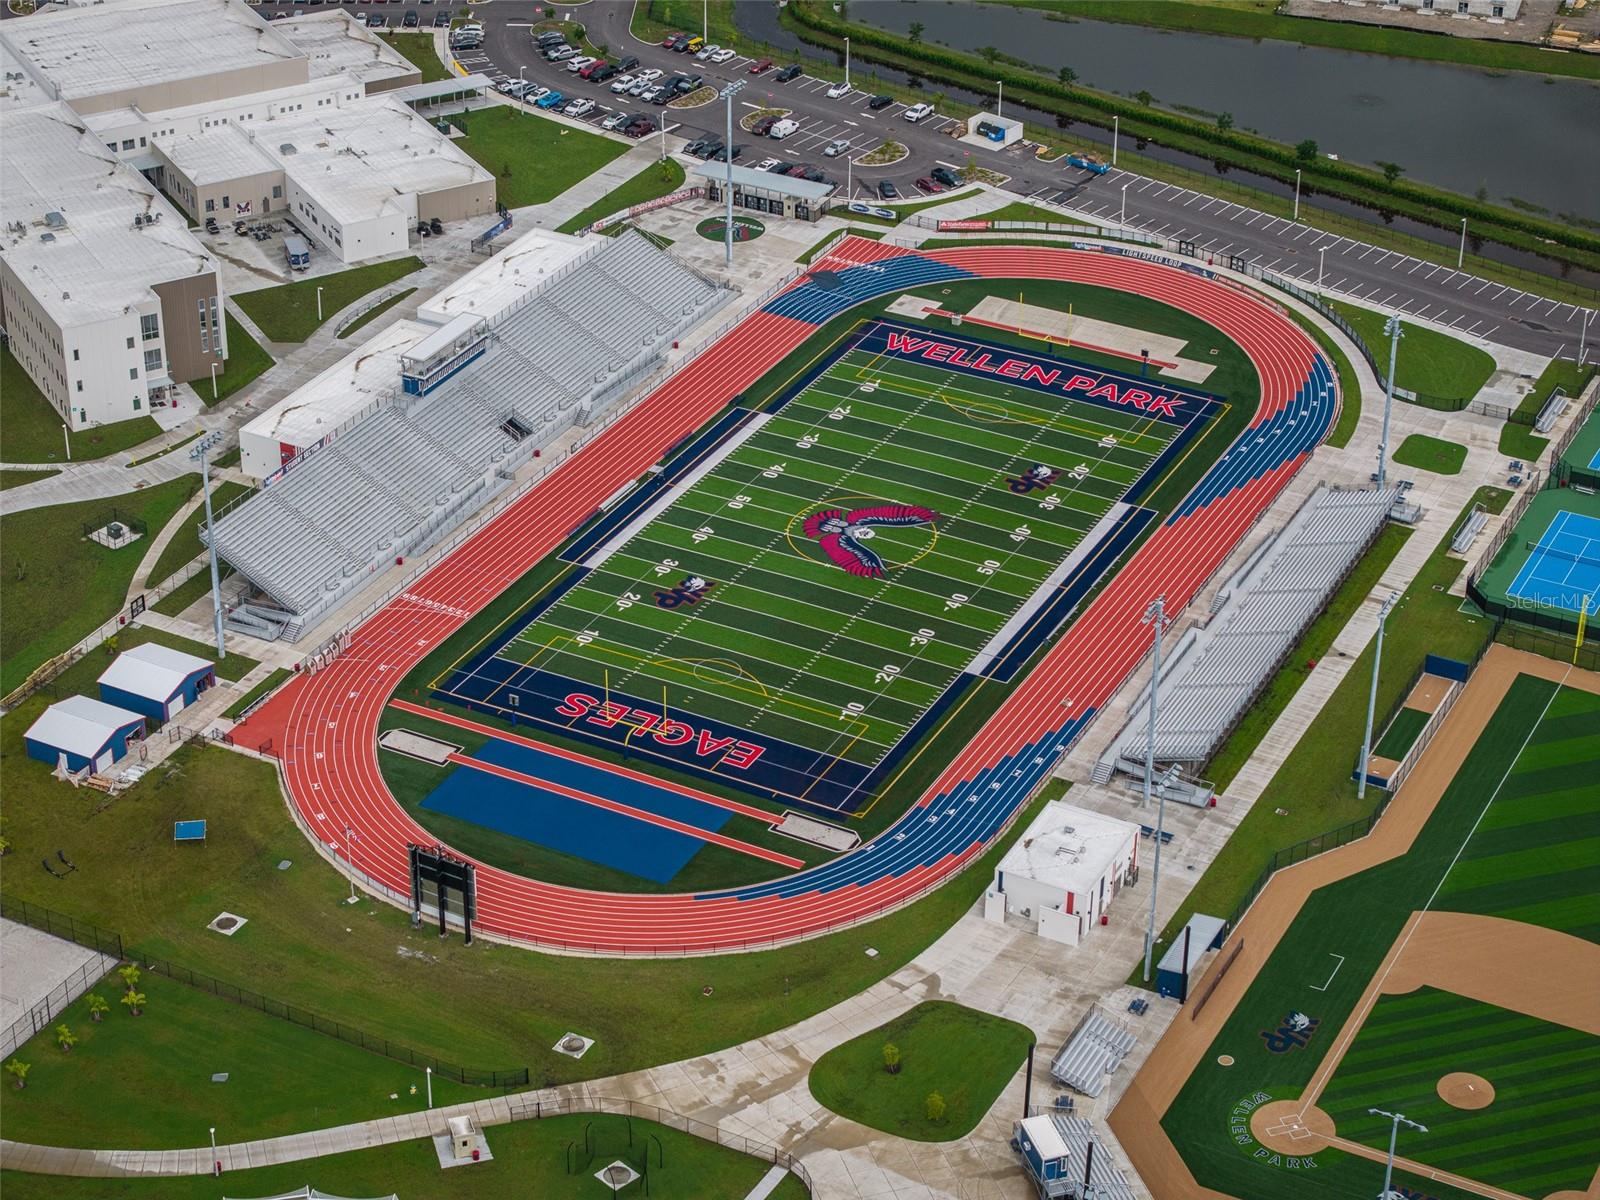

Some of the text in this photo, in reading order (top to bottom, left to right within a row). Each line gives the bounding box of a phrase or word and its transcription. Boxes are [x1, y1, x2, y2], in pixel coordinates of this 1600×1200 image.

[887, 332, 1187, 417] WELLEN PARK
[860, 382, 879, 393] 10
[828, 407, 850, 420] 20
[796, 435, 818, 449] 30
[1097, 436, 1117, 448] 10
[762, 464, 784, 479] 40
[1067, 465, 1090, 480] 20
[727, 495, 752, 509] 50
[1039, 495, 1061, 511] 30
[691, 526, 715, 541] 40
[1009, 527, 1031, 542] 40
[654, 558, 679, 574] 30
[976, 559, 1000, 575] 50
[616, 592, 641, 608] 20
[946, 593, 969, 609] 40
[576, 630, 600, 644] 10
[911, 628, 936, 645] 30
[875, 664, 901, 682] 20
[841, 702, 865, 717] 10
[555, 692, 767, 769] EAGLES
[1231, 1091, 1318, 1169] WELLEN PARK
